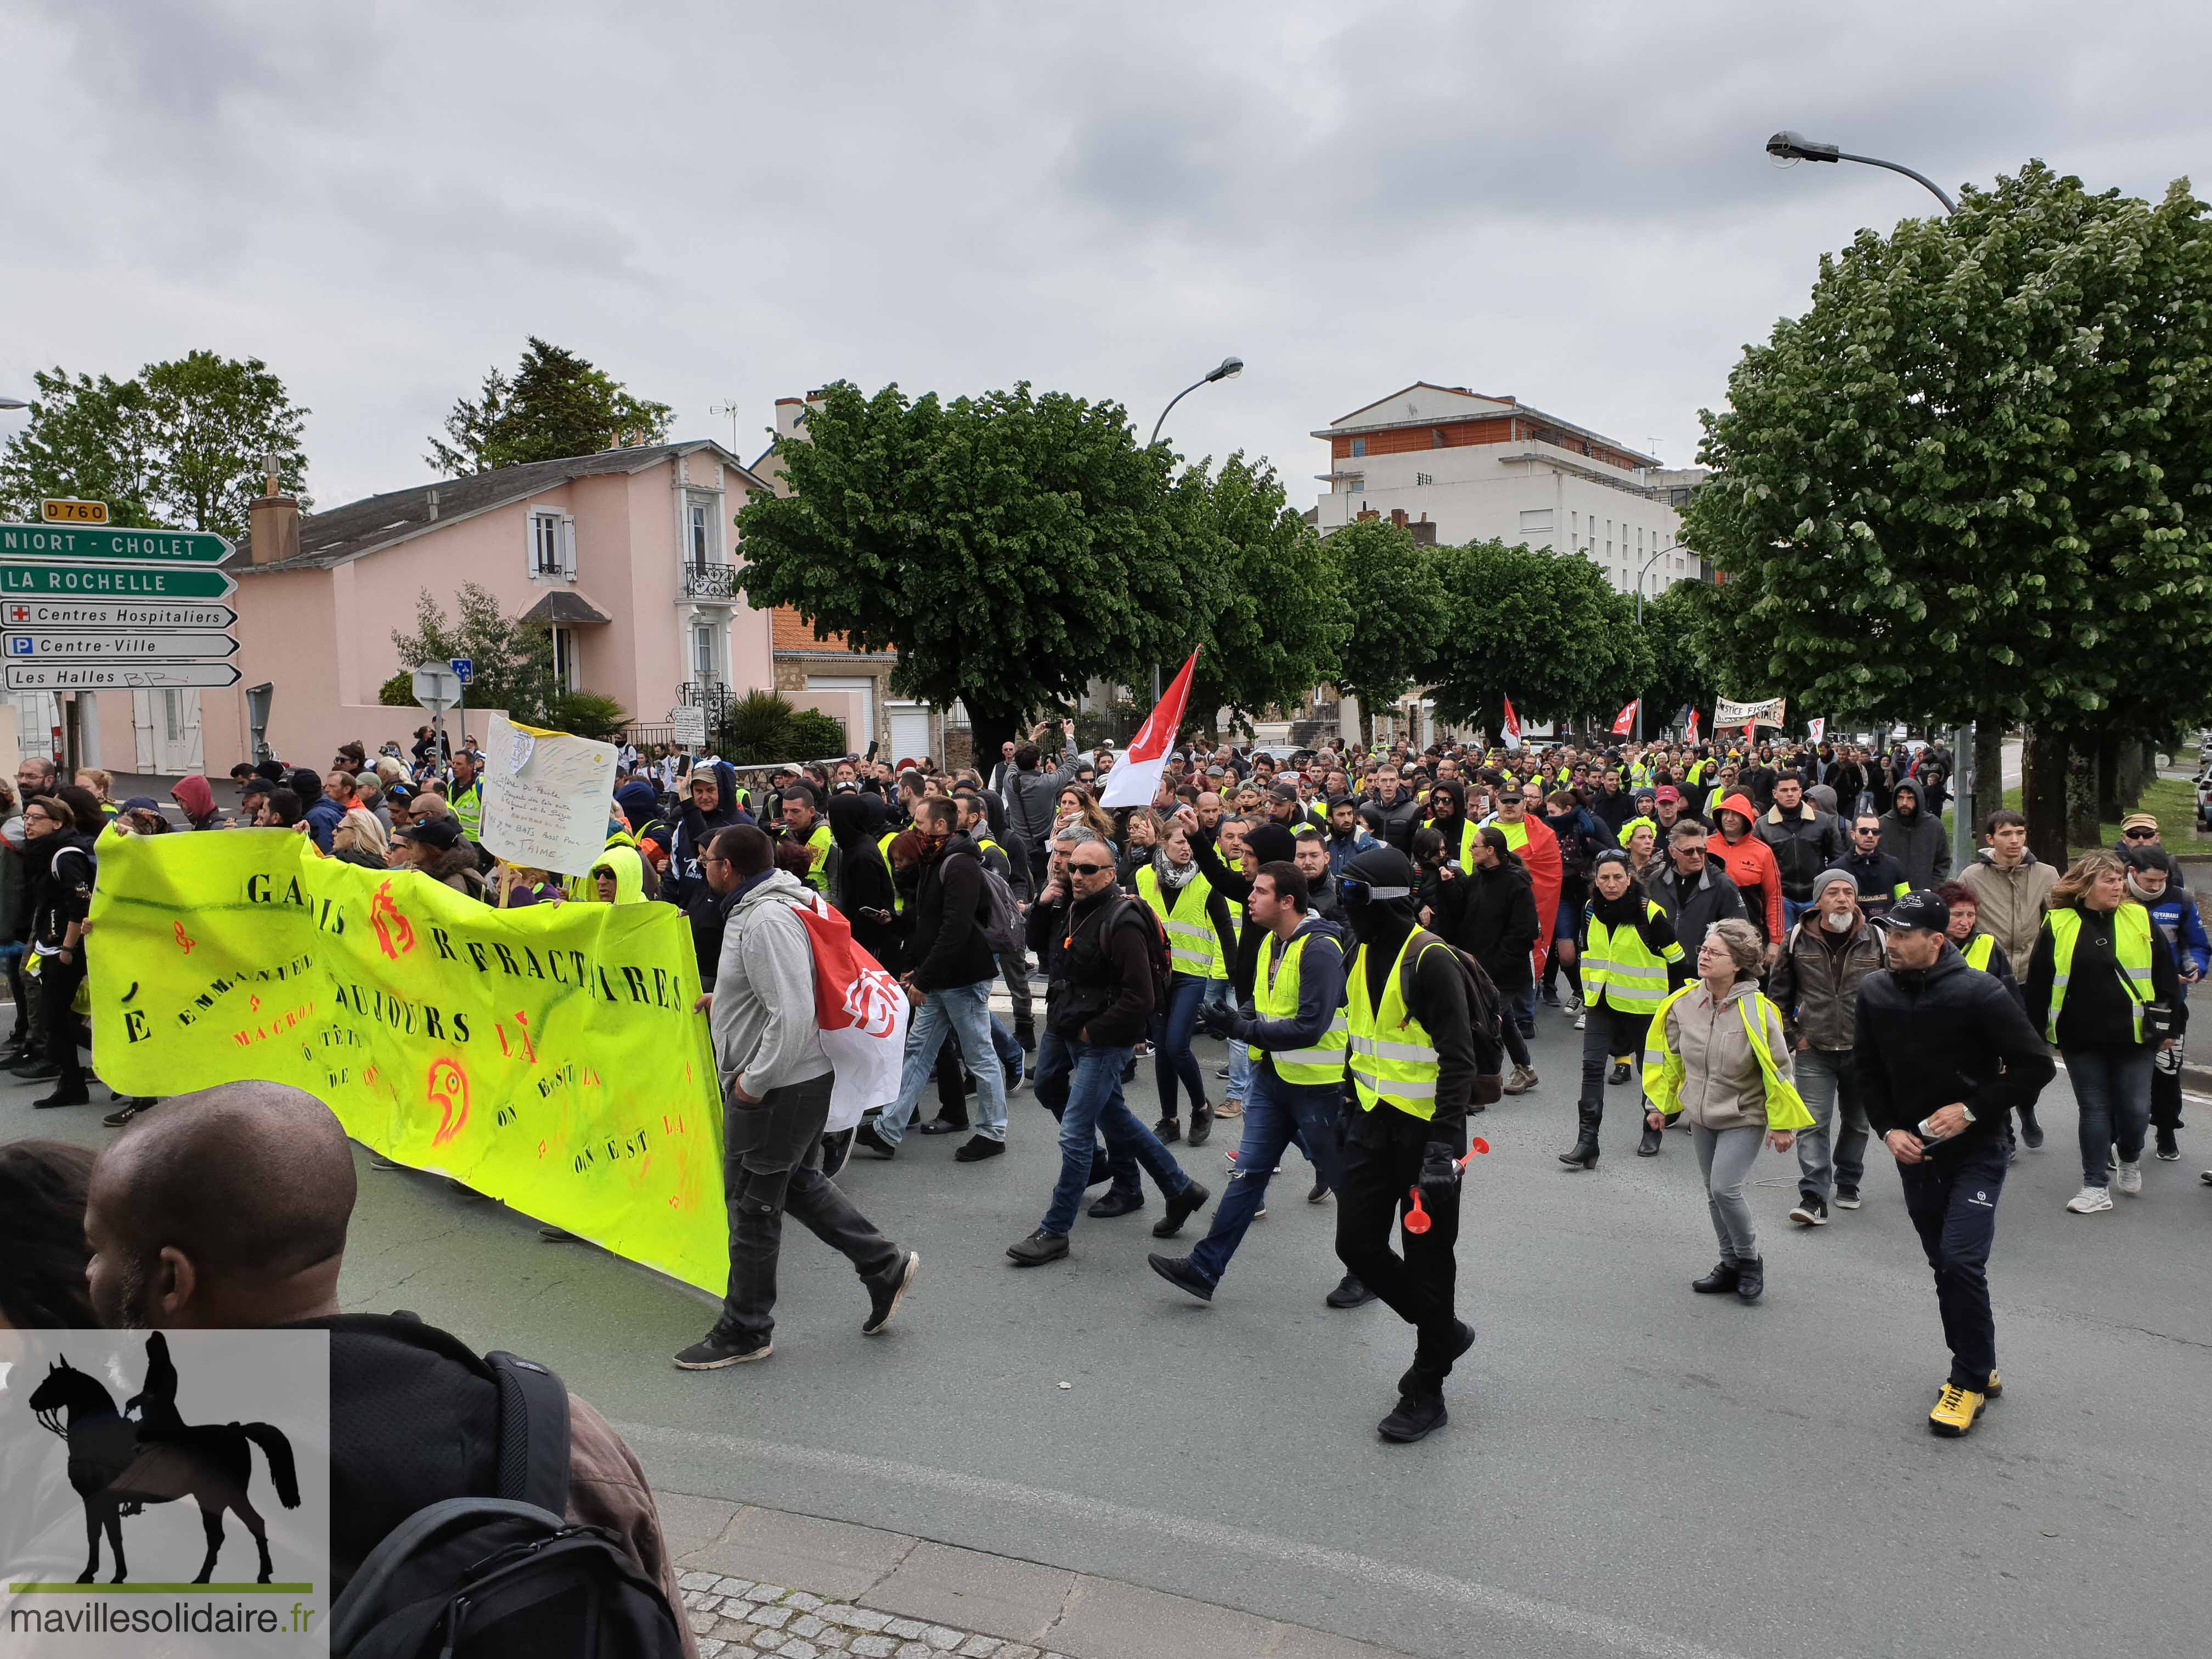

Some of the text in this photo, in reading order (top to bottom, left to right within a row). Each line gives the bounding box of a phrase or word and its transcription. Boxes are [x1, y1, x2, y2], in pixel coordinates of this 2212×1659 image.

[48, 504, 103, 518] D 760
[5, 532, 75, 550] NIORT
[111, 537, 194, 555] CHOLET
[8, 571, 165, 591] LA ROCHELLE
[38, 608, 219, 624] Centres Hospitaliers
[41, 639, 155, 652] Centre-Ville
[16, 670, 114, 683] Les Halles
